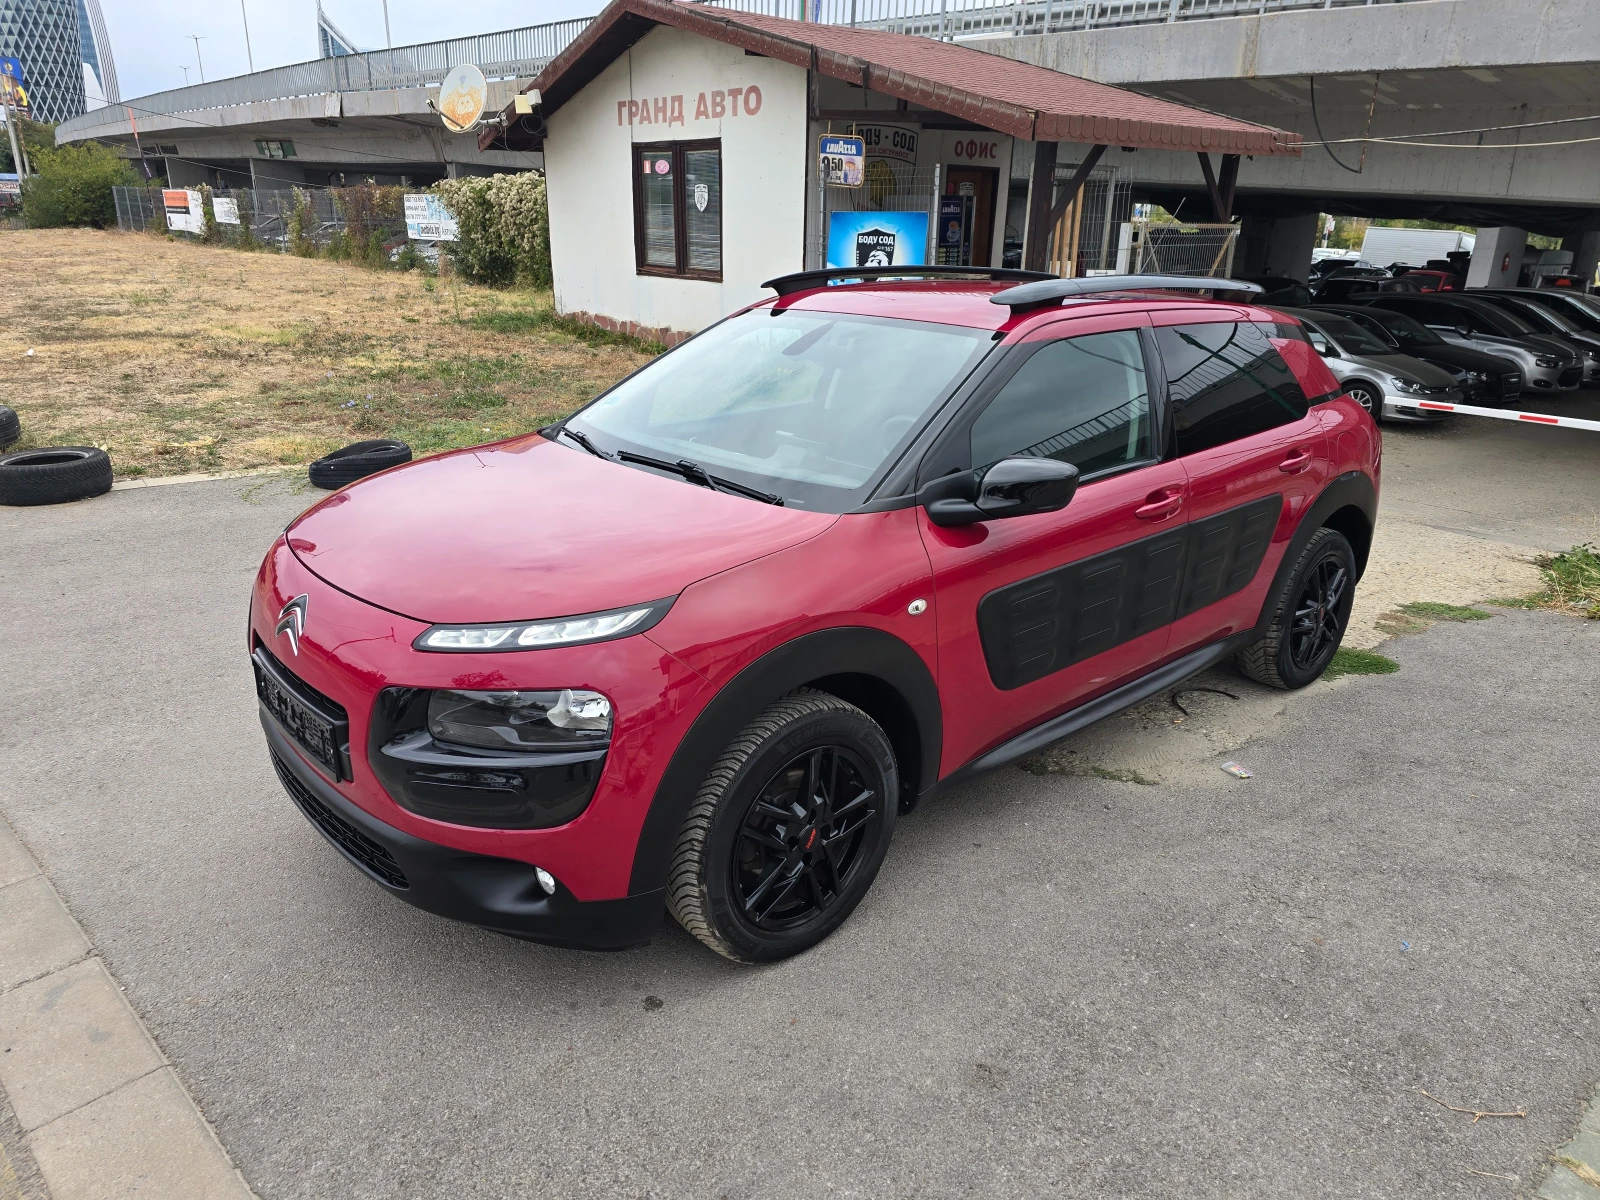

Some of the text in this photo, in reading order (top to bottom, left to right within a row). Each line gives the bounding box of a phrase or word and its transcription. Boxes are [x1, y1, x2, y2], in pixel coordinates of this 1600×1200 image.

[617, 85, 763, 127] ГРАНД АВТО
[826, 140, 857, 155] LAVAZZA
[850, 128, 915, 152] ОДУ СОД
[878, 147, 909, 159] СИГУРНОСТ
[954, 139, 998, 160] ОФИС
[858, 235, 894, 245] БОДУ СОД
